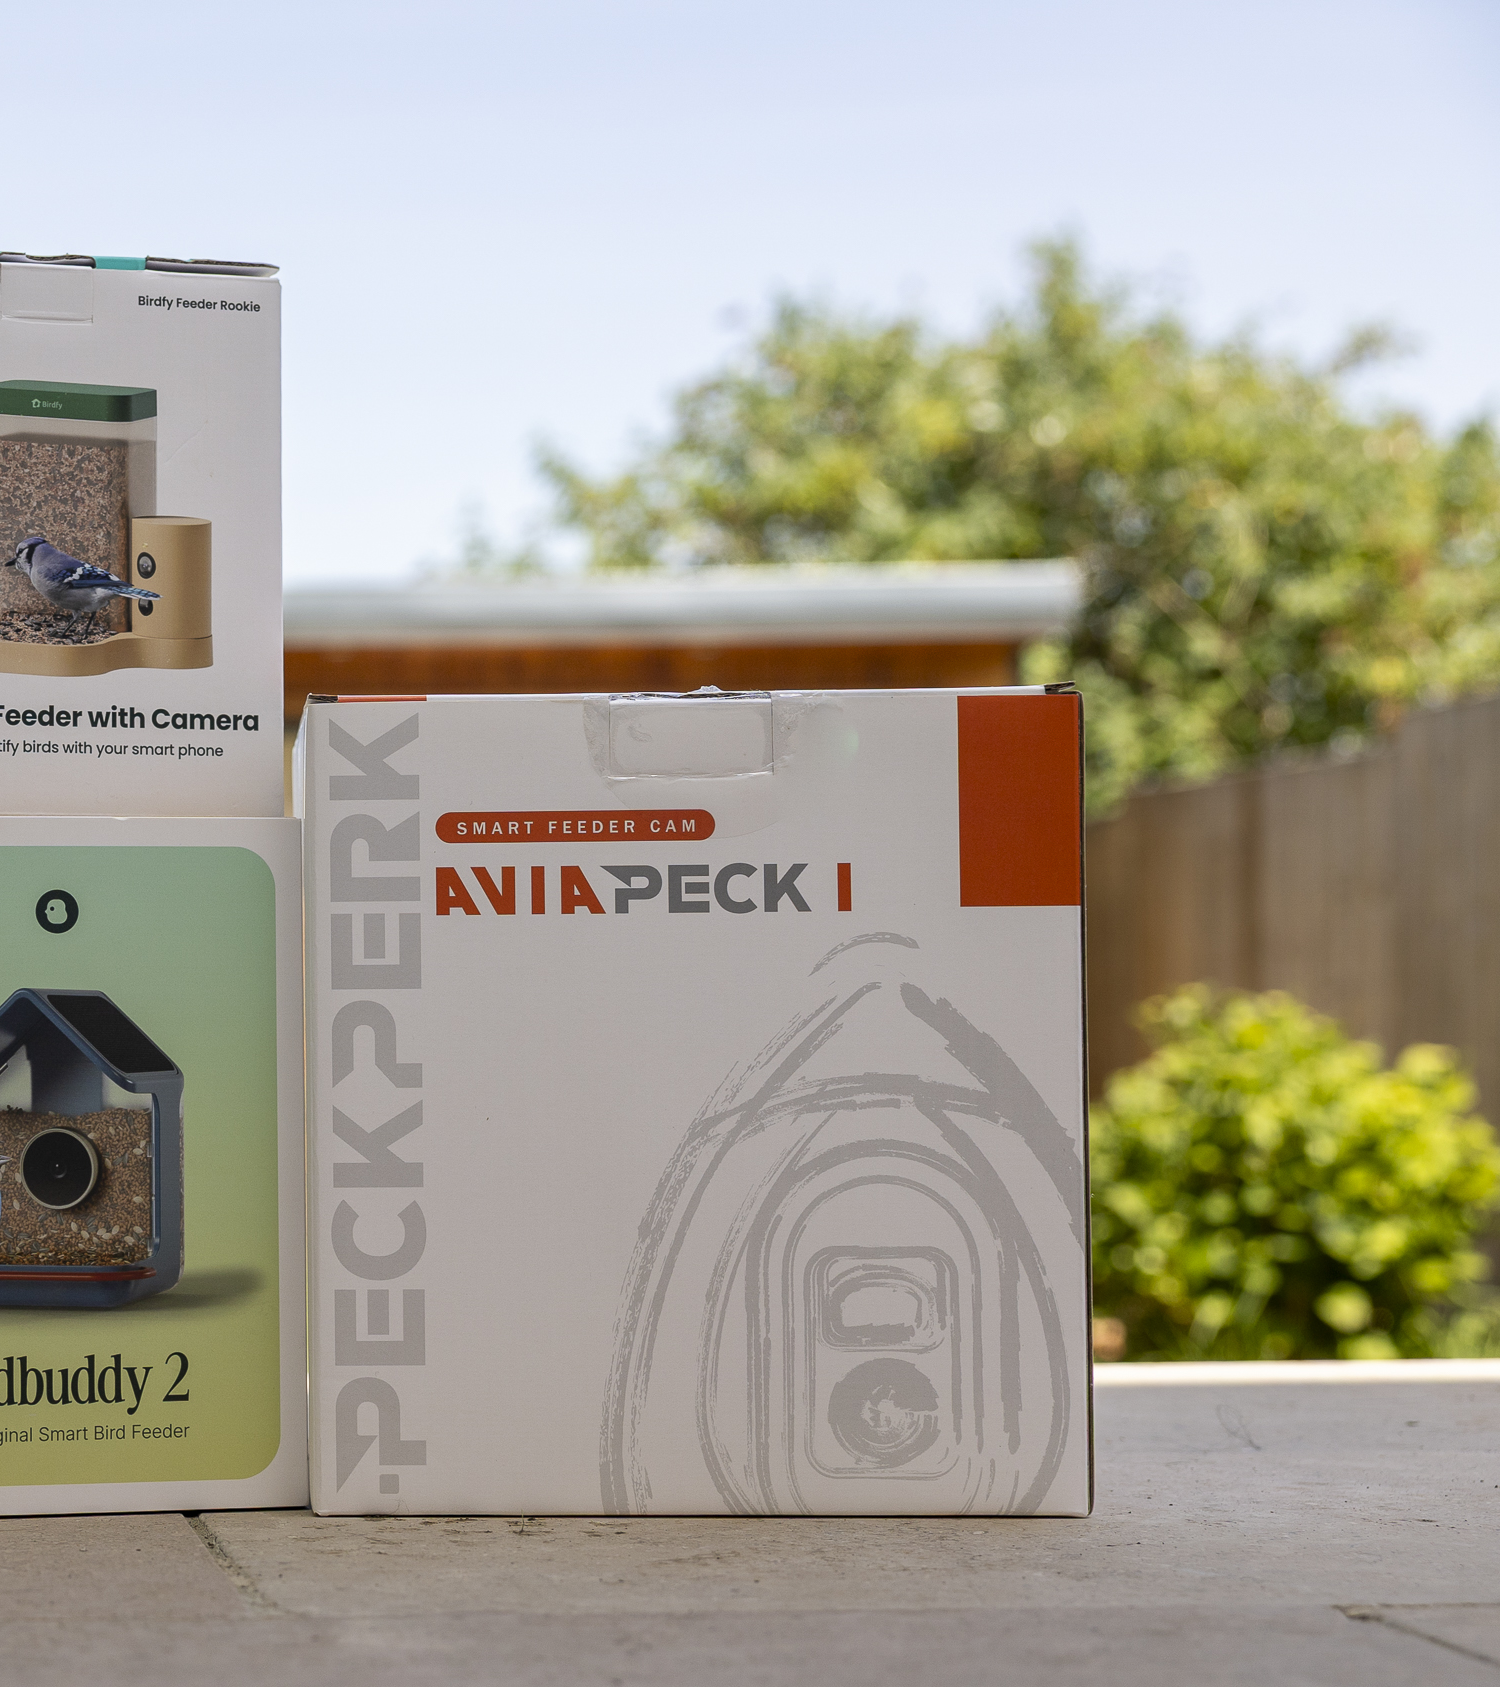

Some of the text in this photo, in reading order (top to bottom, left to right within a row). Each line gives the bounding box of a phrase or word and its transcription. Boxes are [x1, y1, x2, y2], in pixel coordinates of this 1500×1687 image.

[138, 295, 261, 312] Birdfy Feeder Rookie
[42, 400, 63, 410] Birdfy
[88, 704, 146, 730] with
[151, 707, 260, 732] Camera
[23, 739, 59, 755] birds
[63, 740, 93, 756] with
[96, 744, 129, 759] your
[132, 744, 175, 757] smart
[178, 743, 224, 760] phone
[456, 818, 697, 836] SMART FEEDER CAM
[836, 862, 853, 912] I
[162, 1351, 190, 1402] 2
[38, 1425, 89, 1442] Smart
[94, 1424, 126, 1441] Bird
[131, 1423, 190, 1440] Feeder
